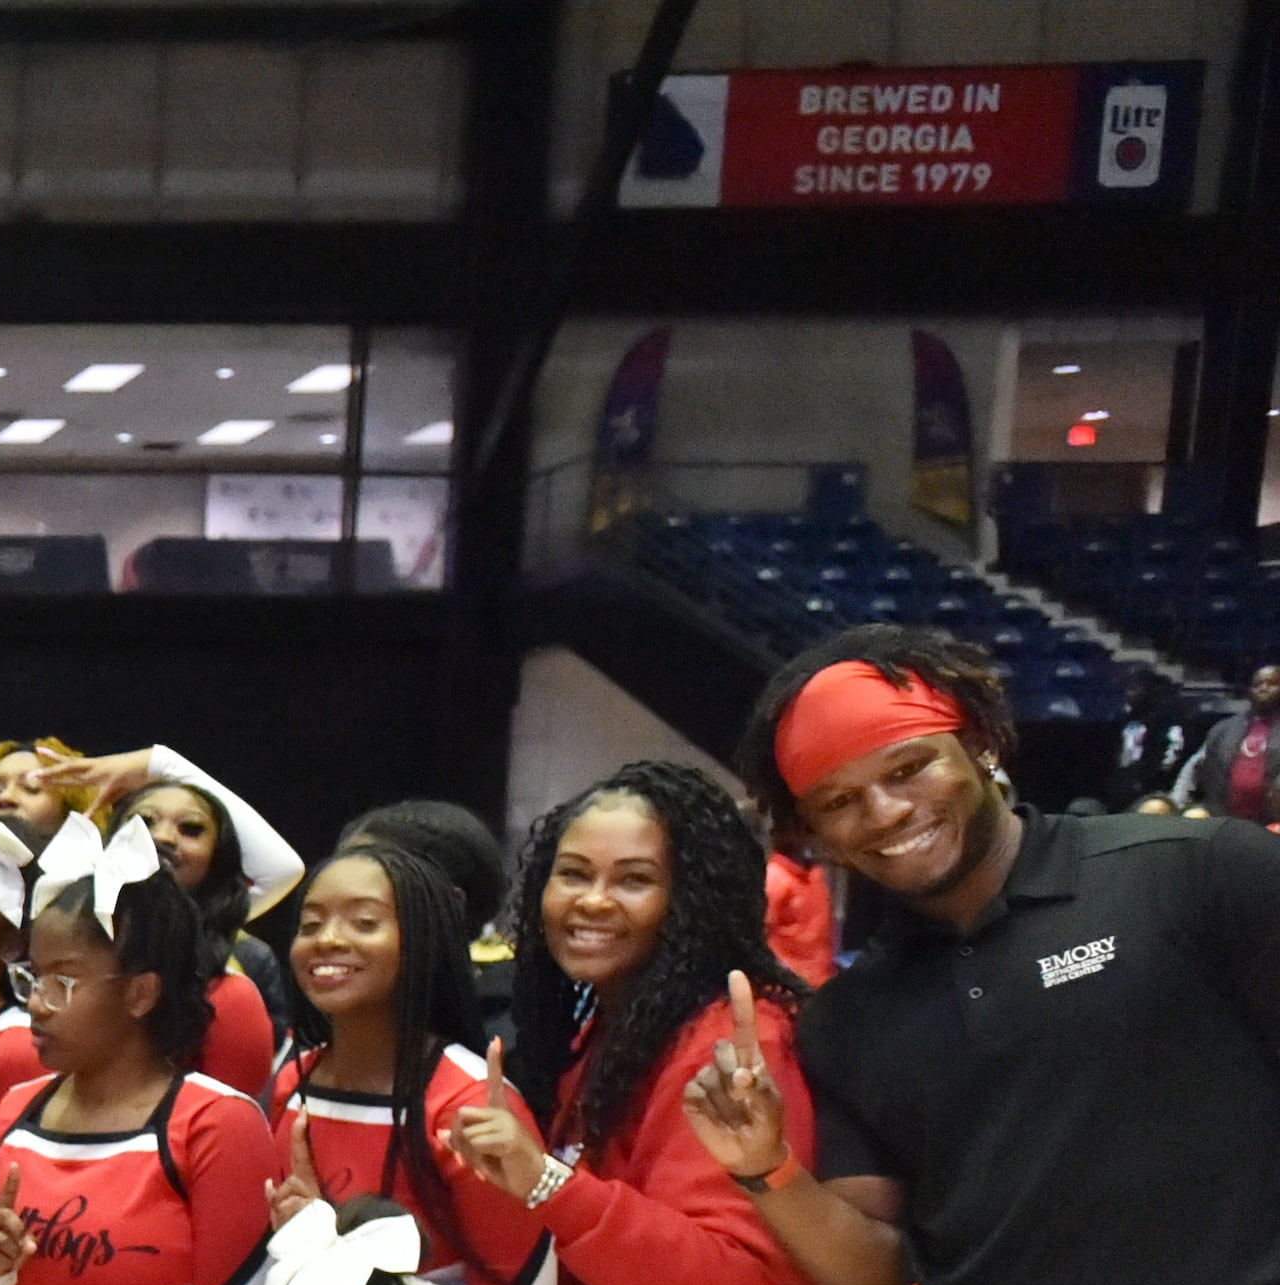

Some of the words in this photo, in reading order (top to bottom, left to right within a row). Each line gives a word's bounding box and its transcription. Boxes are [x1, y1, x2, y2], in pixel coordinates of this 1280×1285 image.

[799, 84, 953, 115] BREWED
[963, 83, 1000, 112] IN
[816, 124, 974, 153] GEORGIA
[794, 164, 901, 194] SINCE
[912, 163, 992, 192] 1979
[1037, 936, 1117, 974] EMORY
